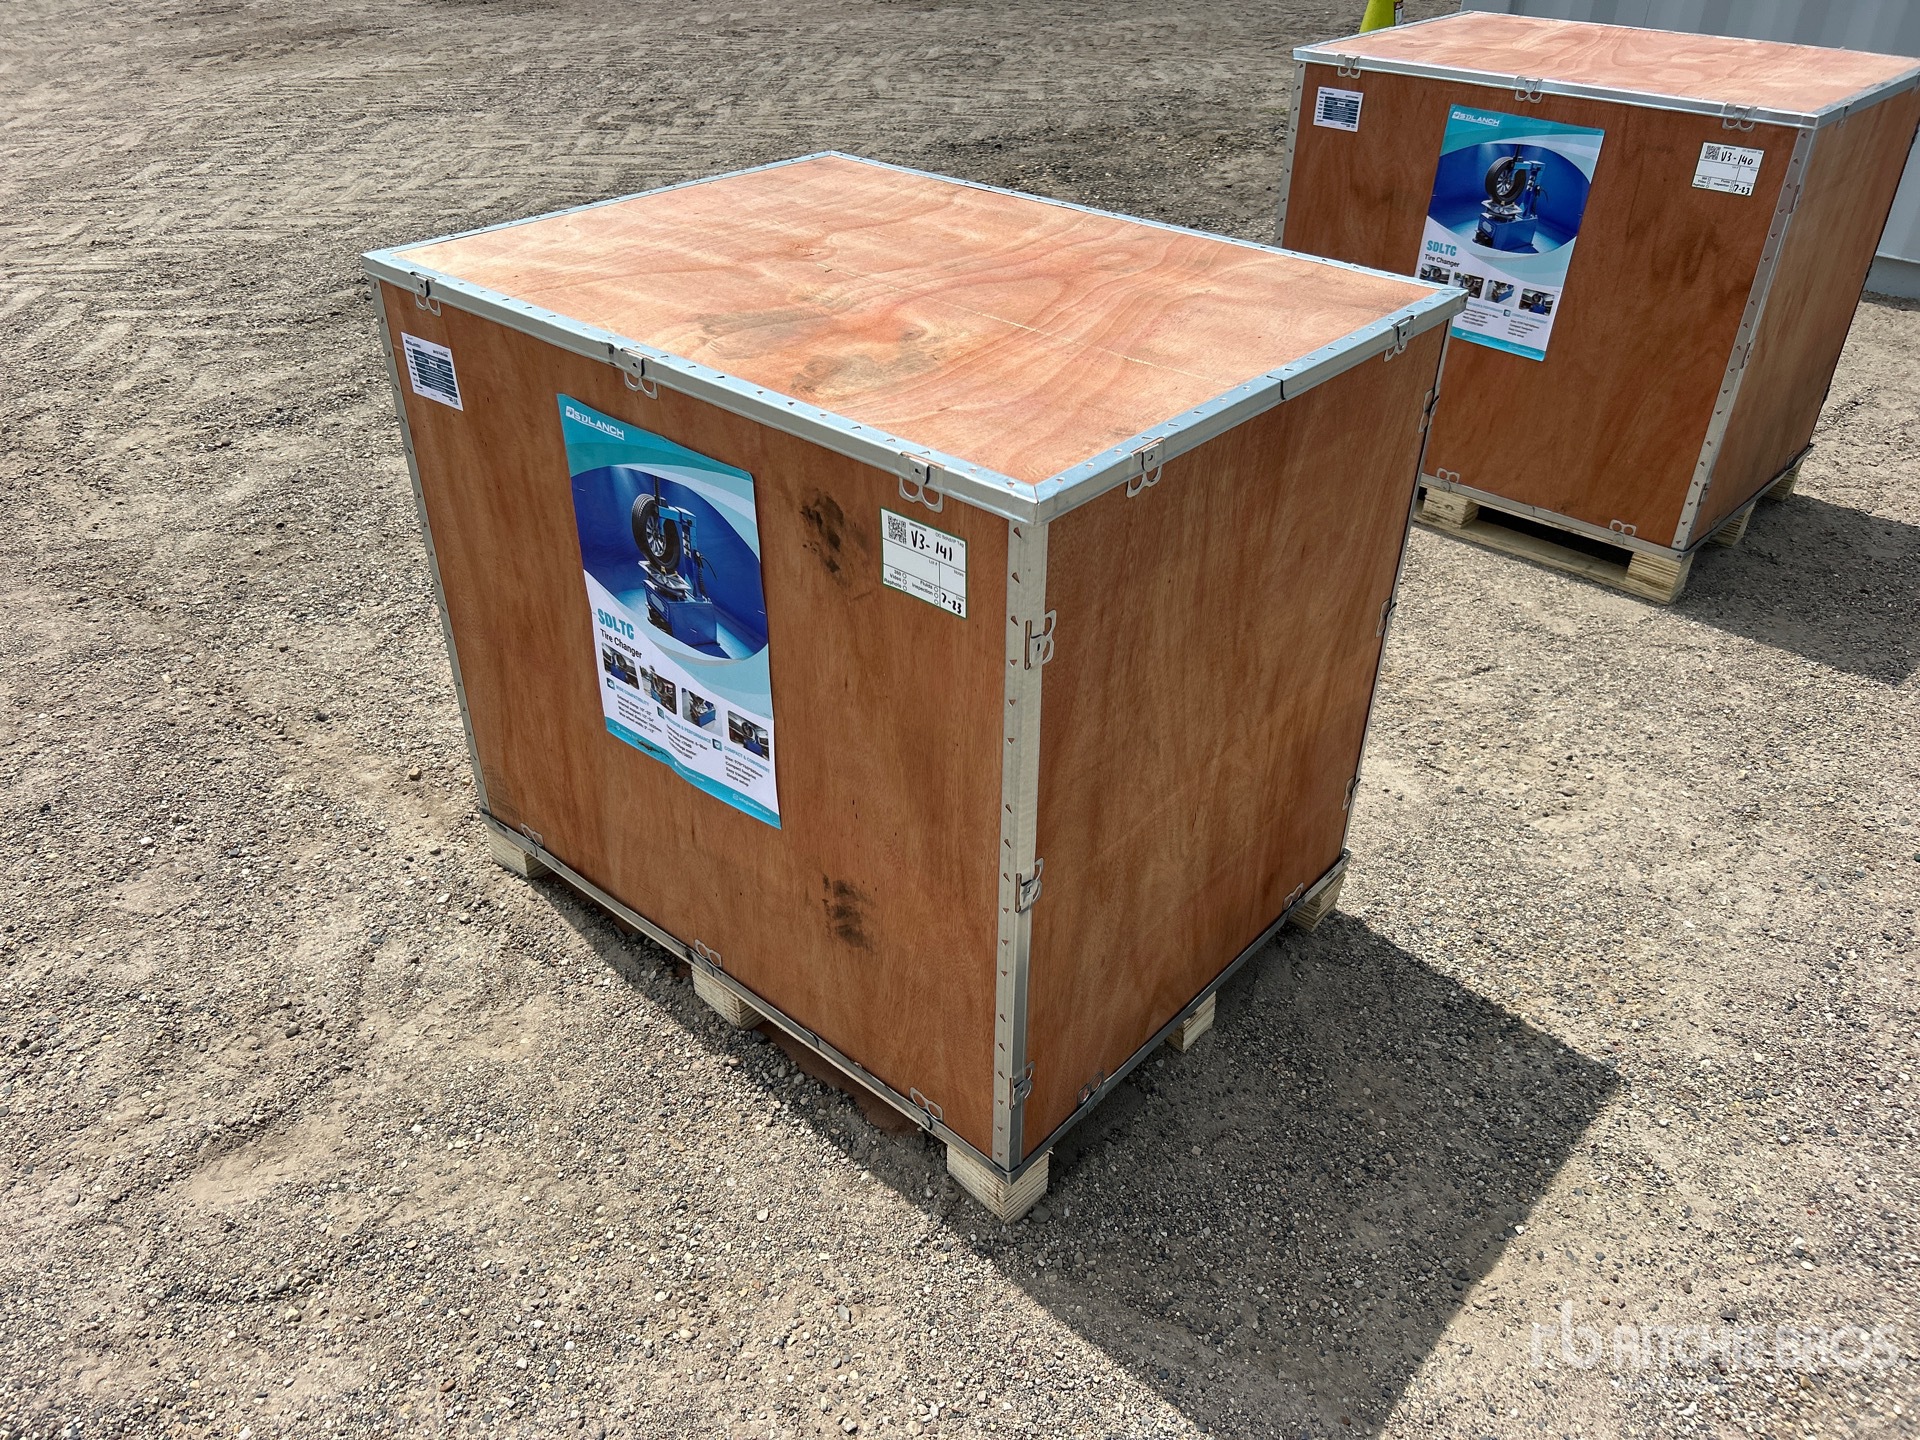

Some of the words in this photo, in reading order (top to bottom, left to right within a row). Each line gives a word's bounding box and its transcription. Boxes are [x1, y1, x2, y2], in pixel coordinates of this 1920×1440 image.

[1734, 184, 1750, 195] 7-23
[1426, 240, 1457, 256] SDLTC
[1424, 254, 1436, 262] Tire
[1436, 256, 1460, 268] Changer
[573, 411, 624, 440] SDLANCH
[890, 573, 902, 582] Video
[920, 580, 933, 590] Fluids
[912, 582, 933, 596] Inspection
[941, 592, 962, 614] 7-23
[598, 608, 634, 640] SDLTC
[600, 628, 613, 643] Tire
[614, 636, 642, 658] Changer
